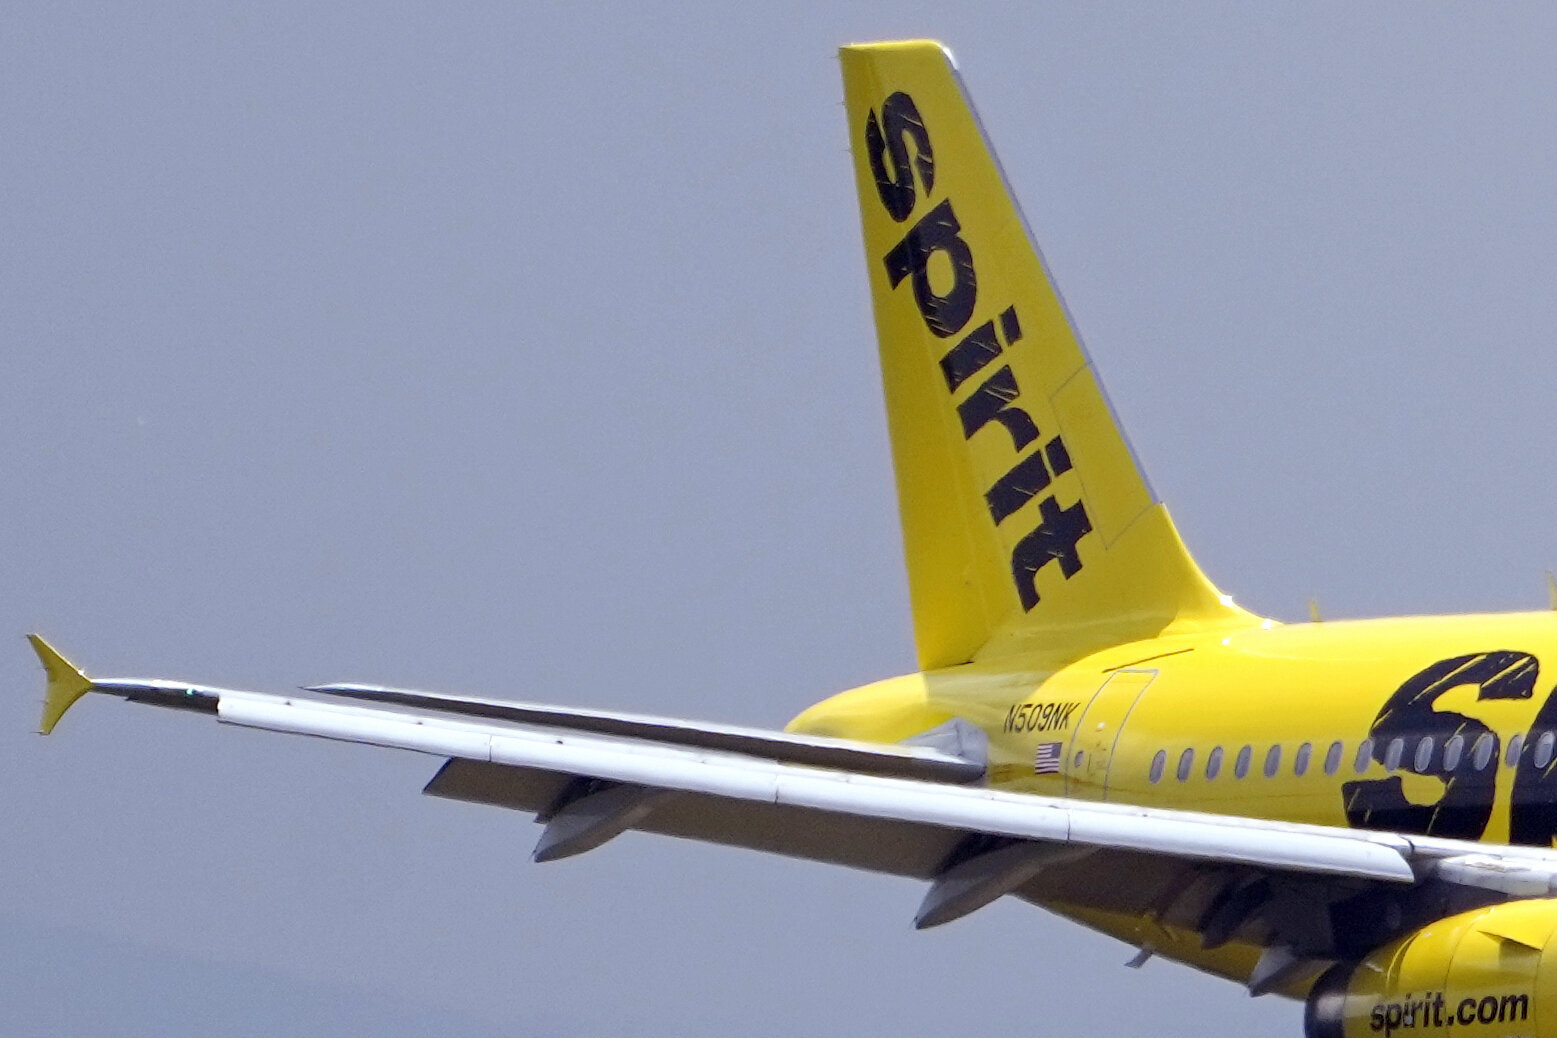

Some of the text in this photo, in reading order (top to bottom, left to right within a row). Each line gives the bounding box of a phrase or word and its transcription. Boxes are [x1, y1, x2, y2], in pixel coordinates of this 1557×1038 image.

[865, 91, 1093, 614] spirit
[1003, 702, 1081, 734] N509NK
[1369, 991, 1529, 1038] spirit.com
